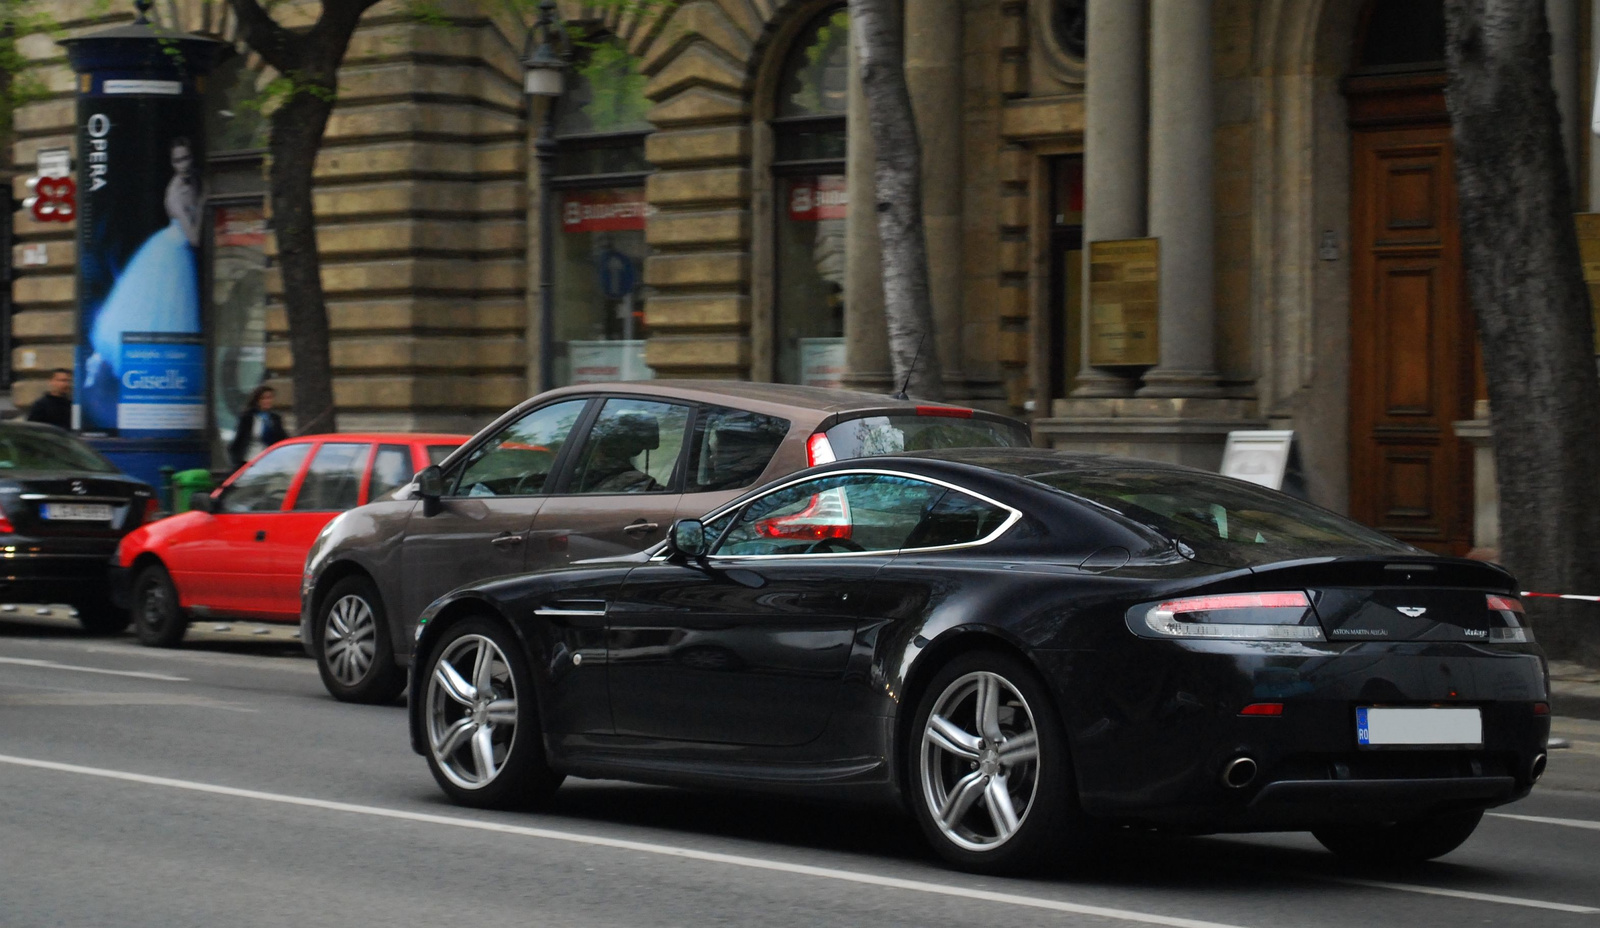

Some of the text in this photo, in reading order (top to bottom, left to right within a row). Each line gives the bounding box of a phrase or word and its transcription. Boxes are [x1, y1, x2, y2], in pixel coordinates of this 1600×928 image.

[87, 113, 110, 192] OPERA
[122, 369, 188, 390] Giselle
[1350, 628, 1370, 636] MARTIN
[1463, 628, 1488, 638] Vantage
[1358, 728, 1369, 740] RO
